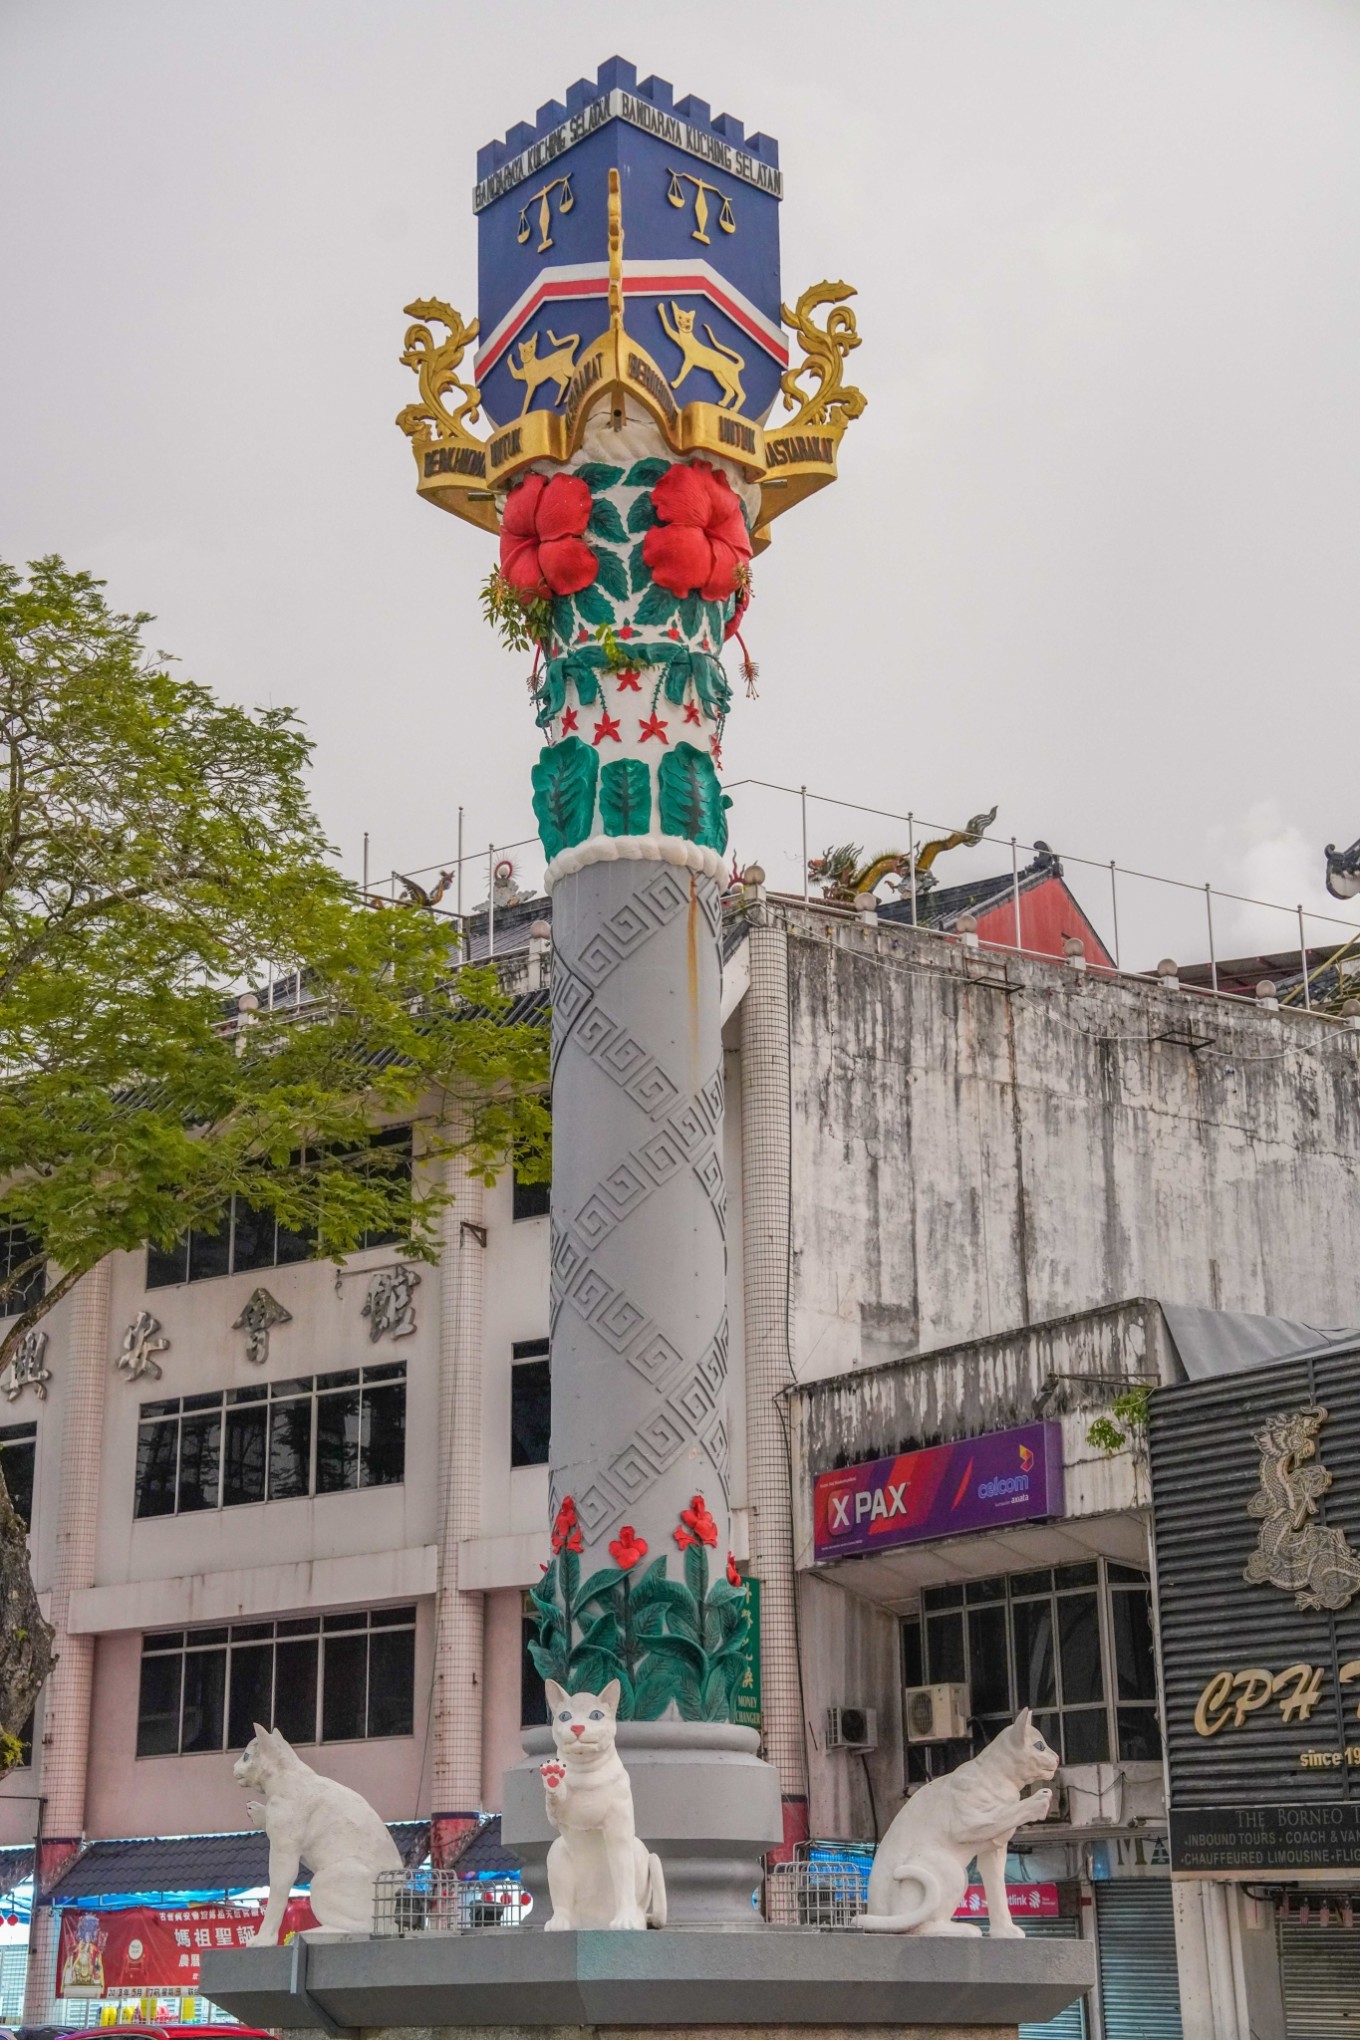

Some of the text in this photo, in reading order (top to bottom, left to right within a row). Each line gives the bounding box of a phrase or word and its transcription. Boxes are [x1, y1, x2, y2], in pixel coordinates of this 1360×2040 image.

[527, 126, 566, 172] KUCHING
[622, 92, 781, 195] BANDARAYA KUCHING SELATAN
[978, 1474, 1029, 1499] celcom
[738, 1695, 757, 1709] MONEY
[1194, 1663, 1325, 1736] CPH
[736, 1710, 760, 1724] CHANGER
[1300, 1749, 1343, 1767] since
[1235, 1810, 1265, 1828] THE
[1278, 1807, 1343, 1827] BORNEO
[1188, 1833, 1236, 1846] INBOUND
[1239, 1832, 1276, 1845] TOURS
[1285, 1831, 1326, 1844] COACH
[1331, 1830, 1338, 1843] &
[1184, 1851, 1263, 1865] CHAUFFEURED
[1267, 1850, 1329, 1864] LIMOUSINE
